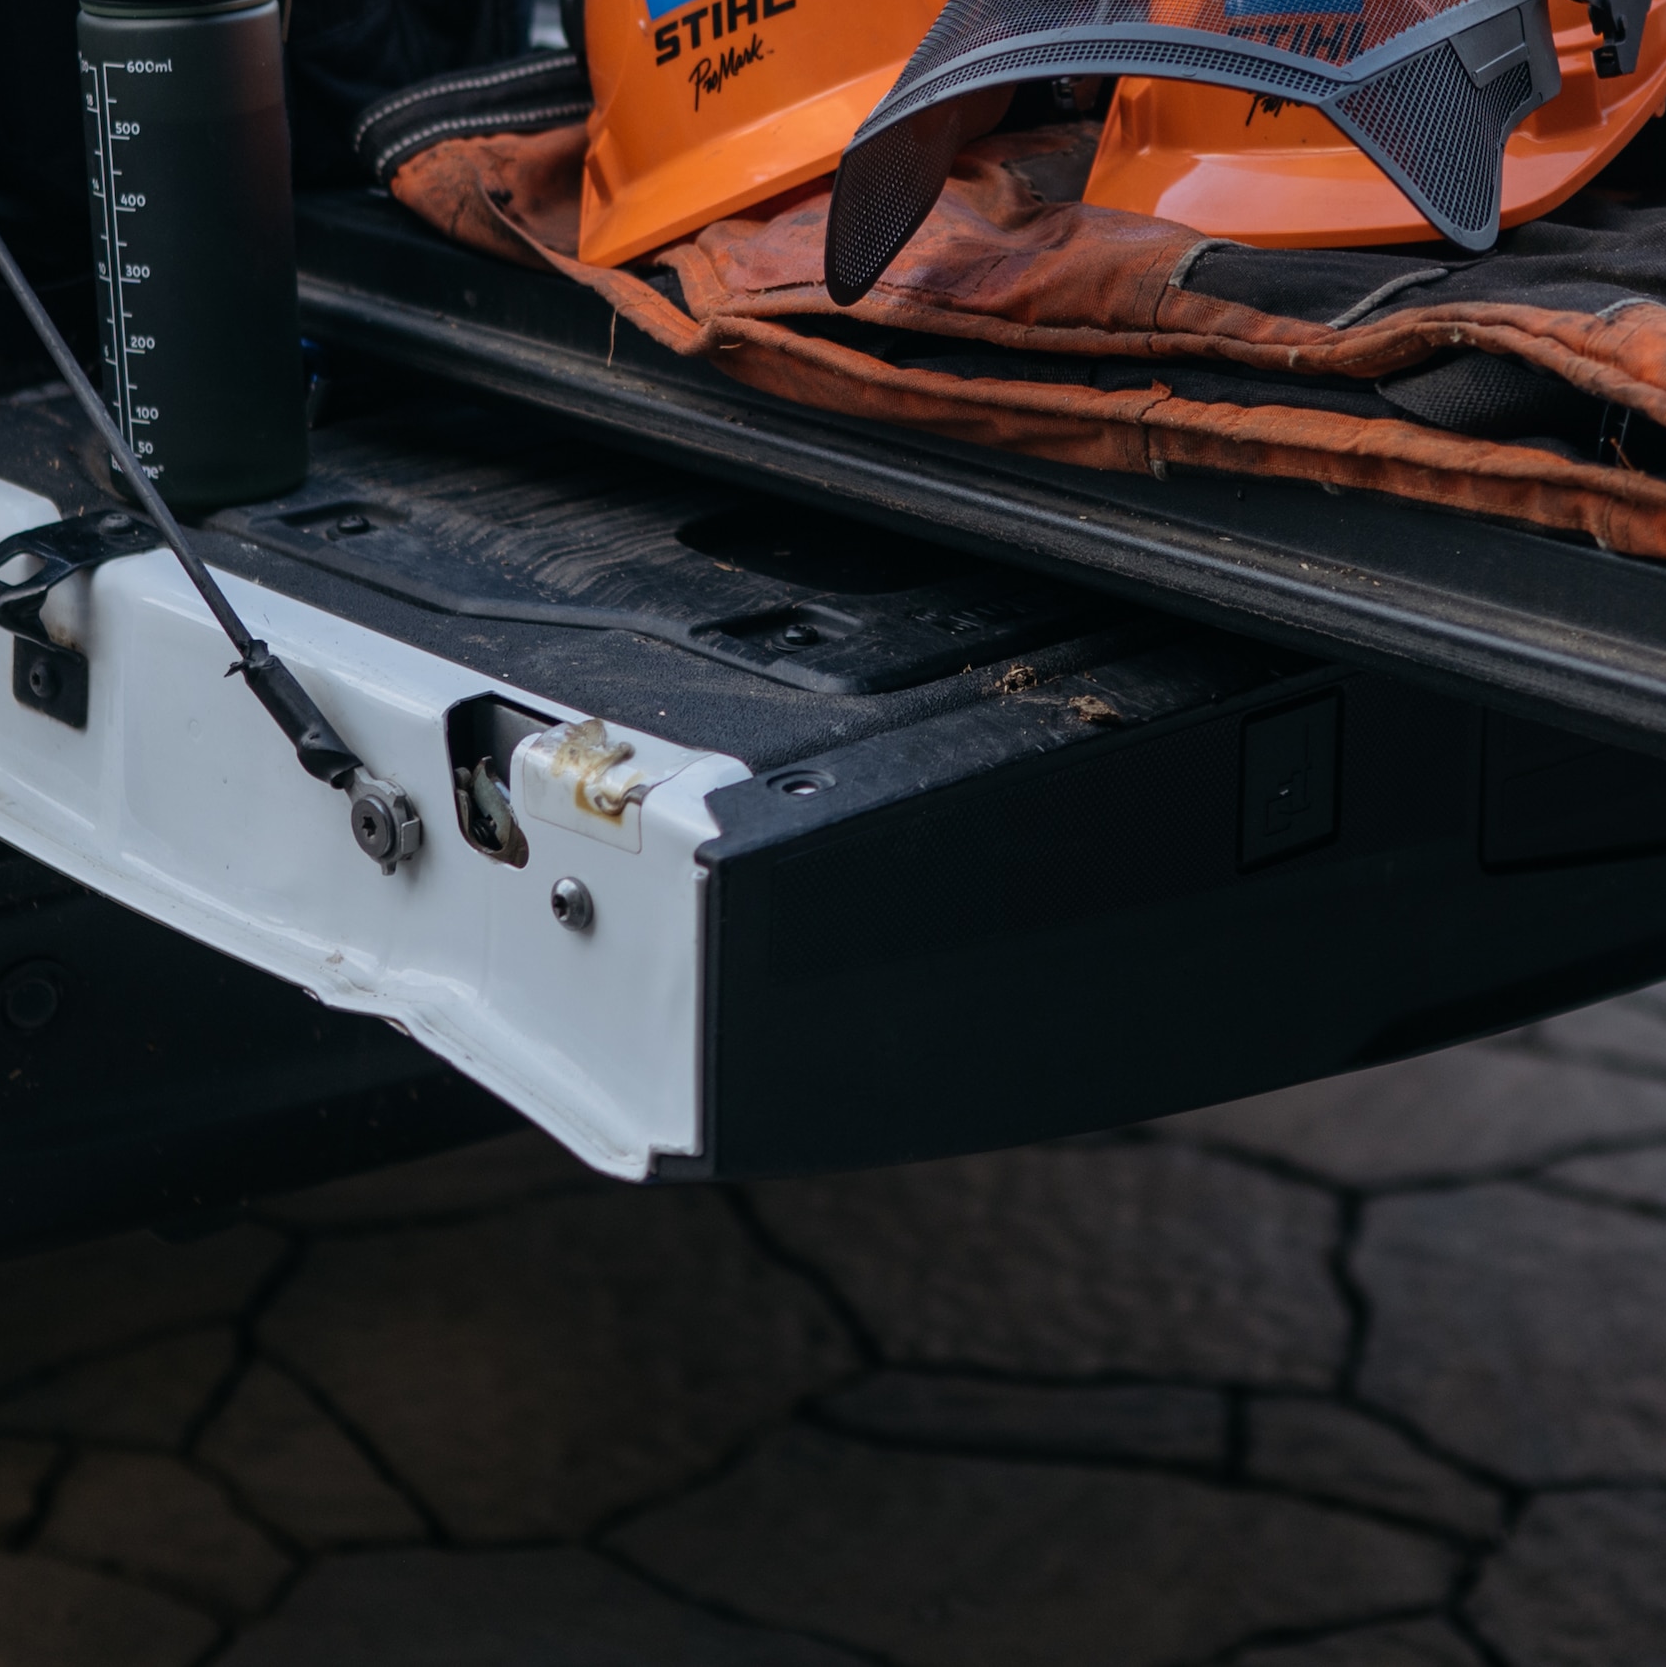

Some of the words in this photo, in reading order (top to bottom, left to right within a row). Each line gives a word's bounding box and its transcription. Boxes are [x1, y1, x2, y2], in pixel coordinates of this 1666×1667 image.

[126, 58, 173, 74] 600ml
[115, 122, 141, 136] 500
[120, 194, 147, 208] 400
[125, 264, 151, 279] 300
[130, 336, 156, 350] 200
[135, 405, 160, 420] 100
[137, 441, 154, 455] 50
